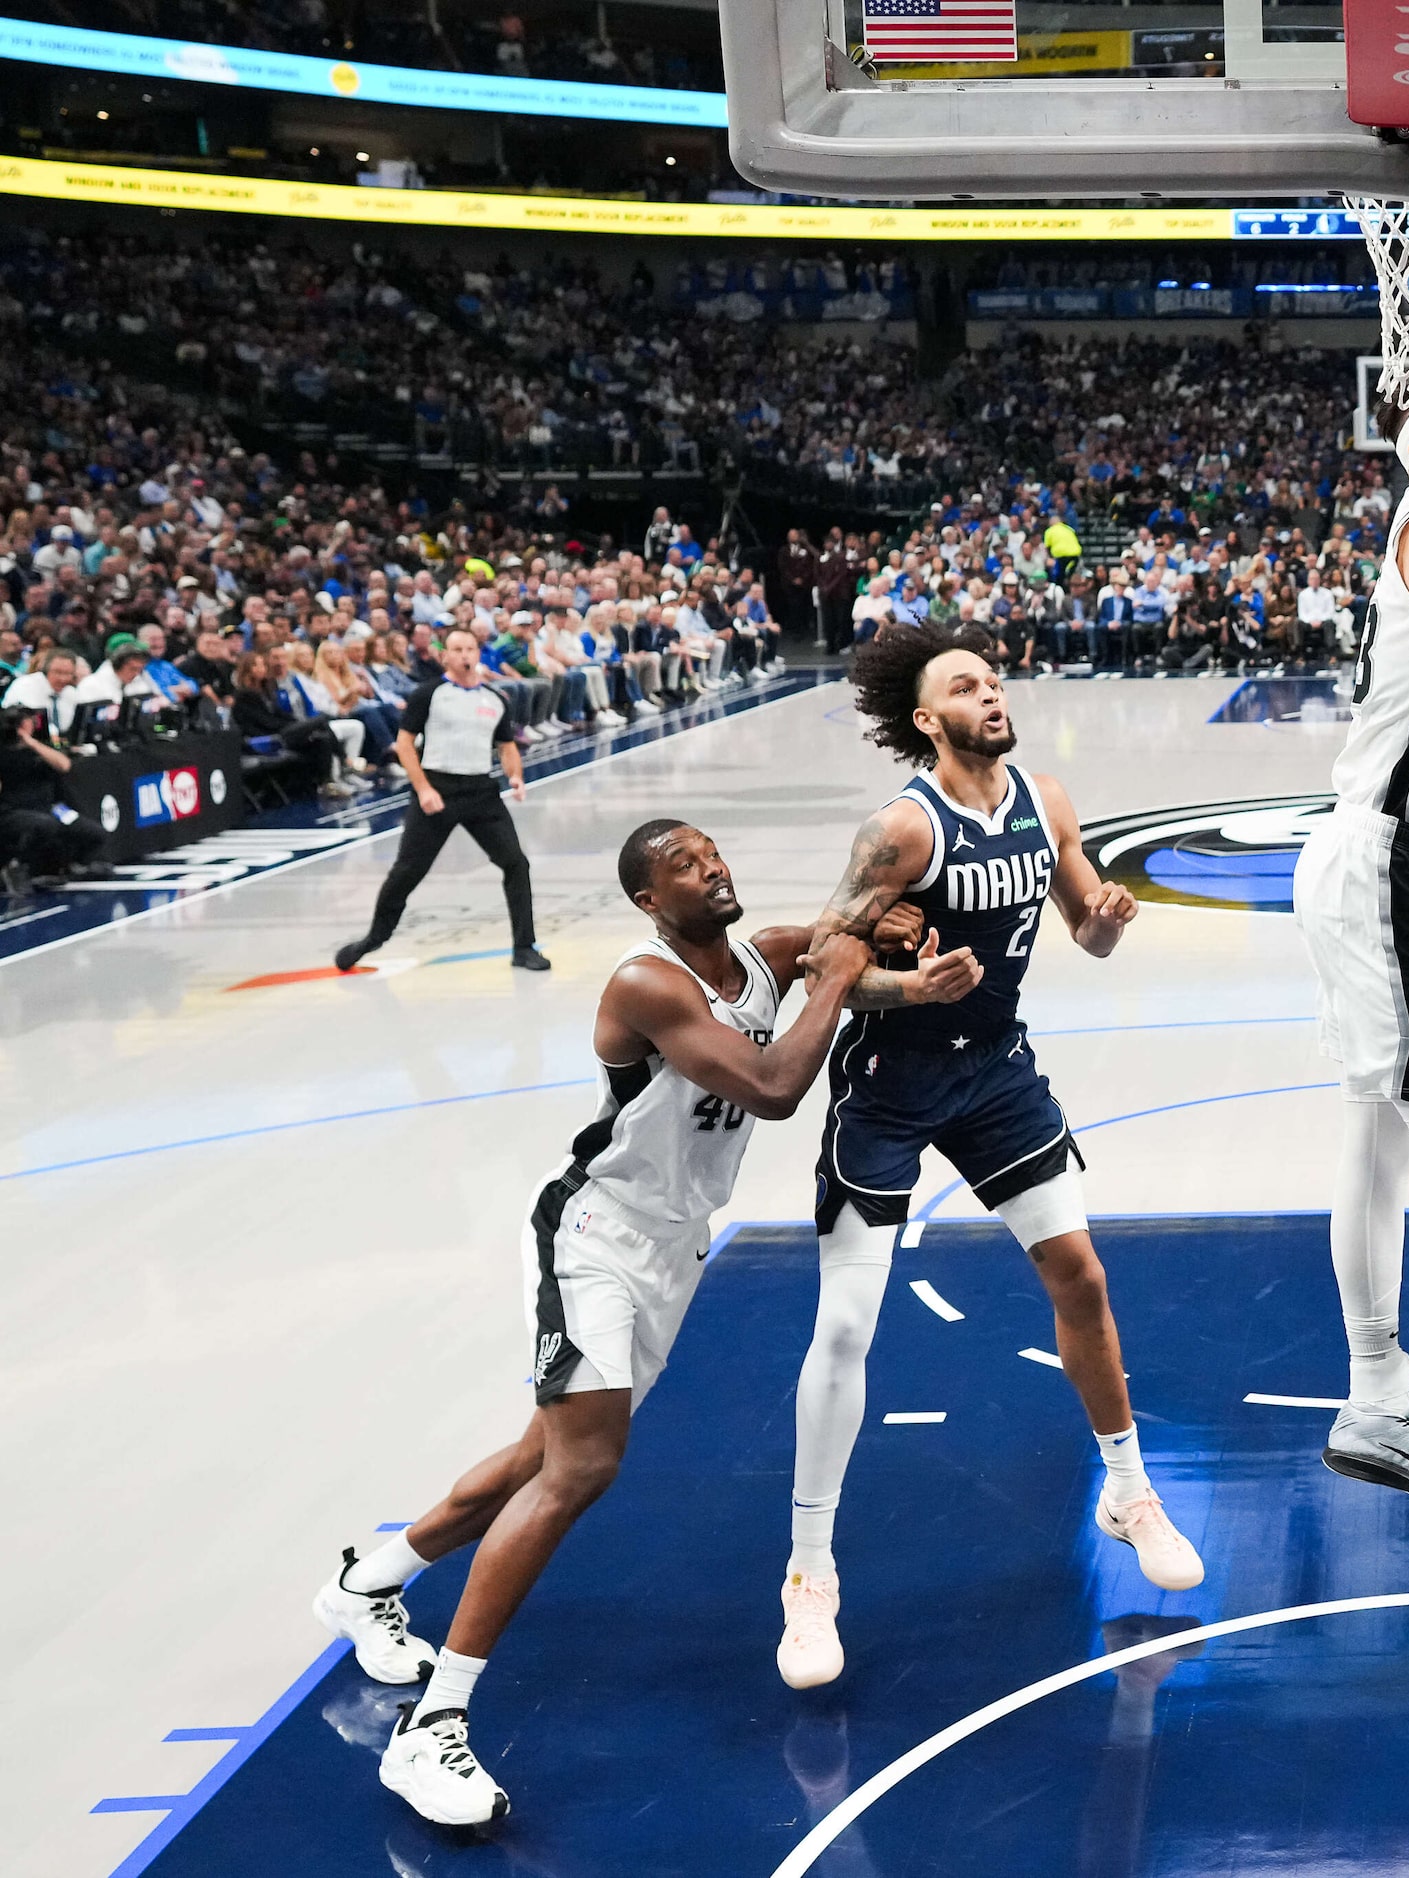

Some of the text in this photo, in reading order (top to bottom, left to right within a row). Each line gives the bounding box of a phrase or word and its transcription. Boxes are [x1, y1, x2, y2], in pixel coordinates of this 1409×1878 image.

[1010, 817, 1039, 833] chime
[946, 848, 1052, 912] MAVS
[1005, 906, 1039, 958] 2
